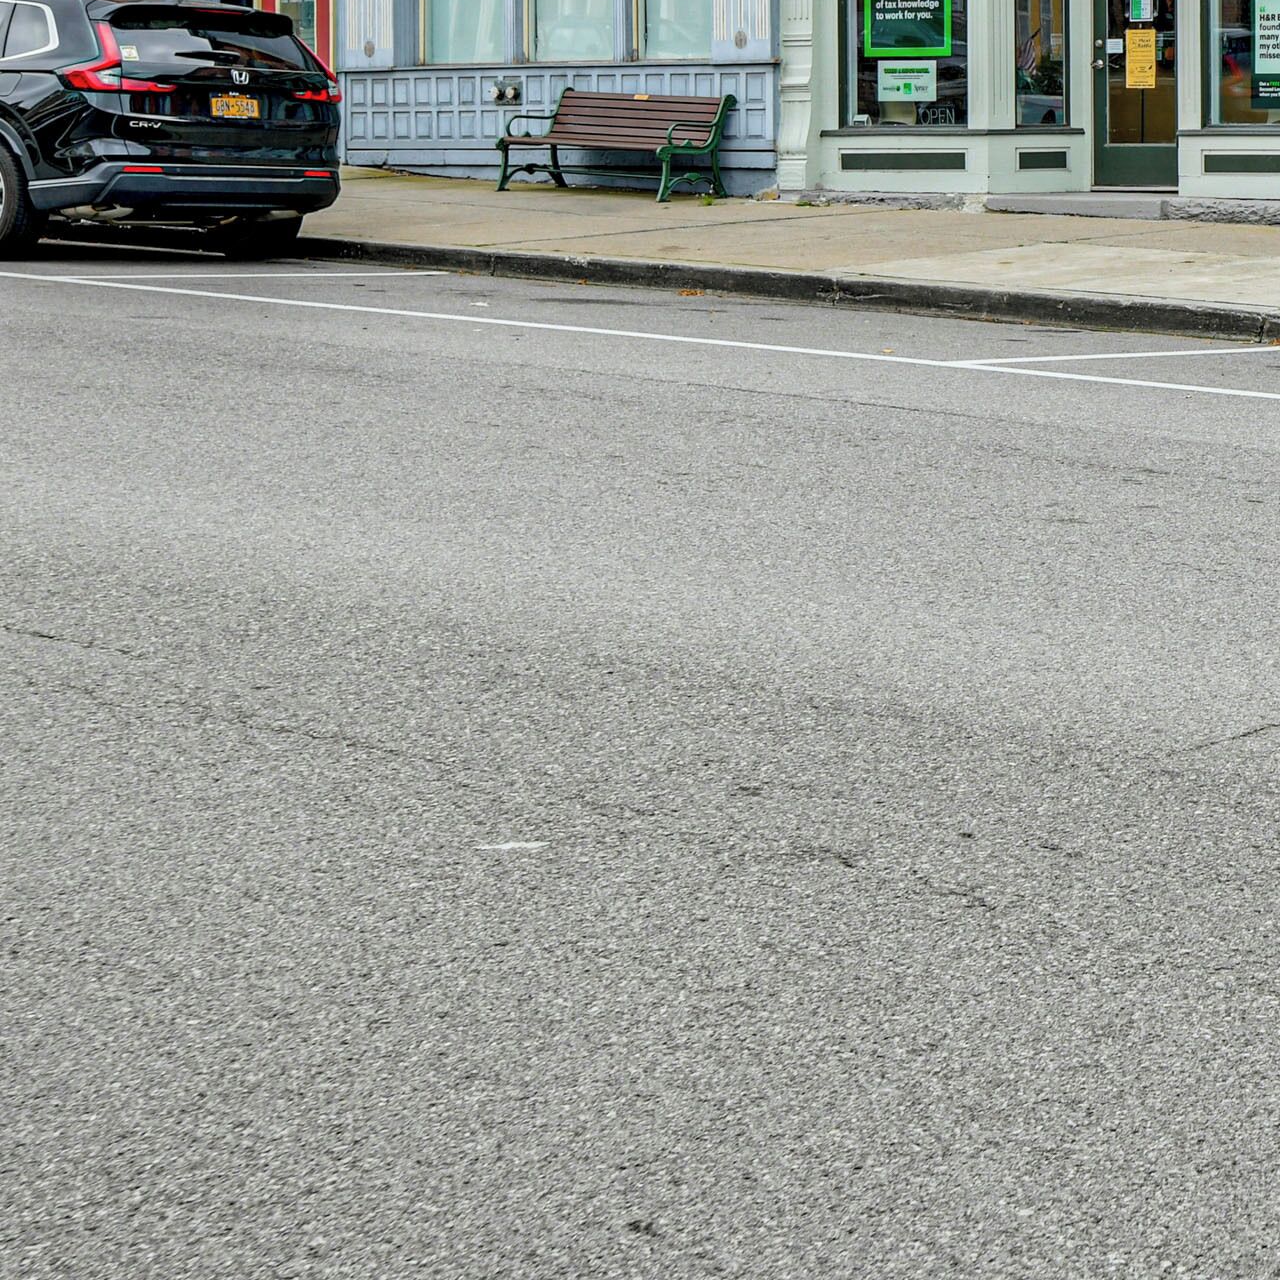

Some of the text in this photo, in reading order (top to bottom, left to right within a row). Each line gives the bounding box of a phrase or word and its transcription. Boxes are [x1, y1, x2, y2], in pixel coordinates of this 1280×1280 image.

[875, 0, 939, 10] of tax knowledge
[876, 10, 933, 21] to work for you.
[1259, 13, 1276, 21] H&R
[1259, 23, 1280, 31] found
[1259, 34, 1279, 42] many
[1259, 43, 1271, 51] my
[920, 107, 955, 125] OPEN
[129, 120, 162, 129] CR-V
